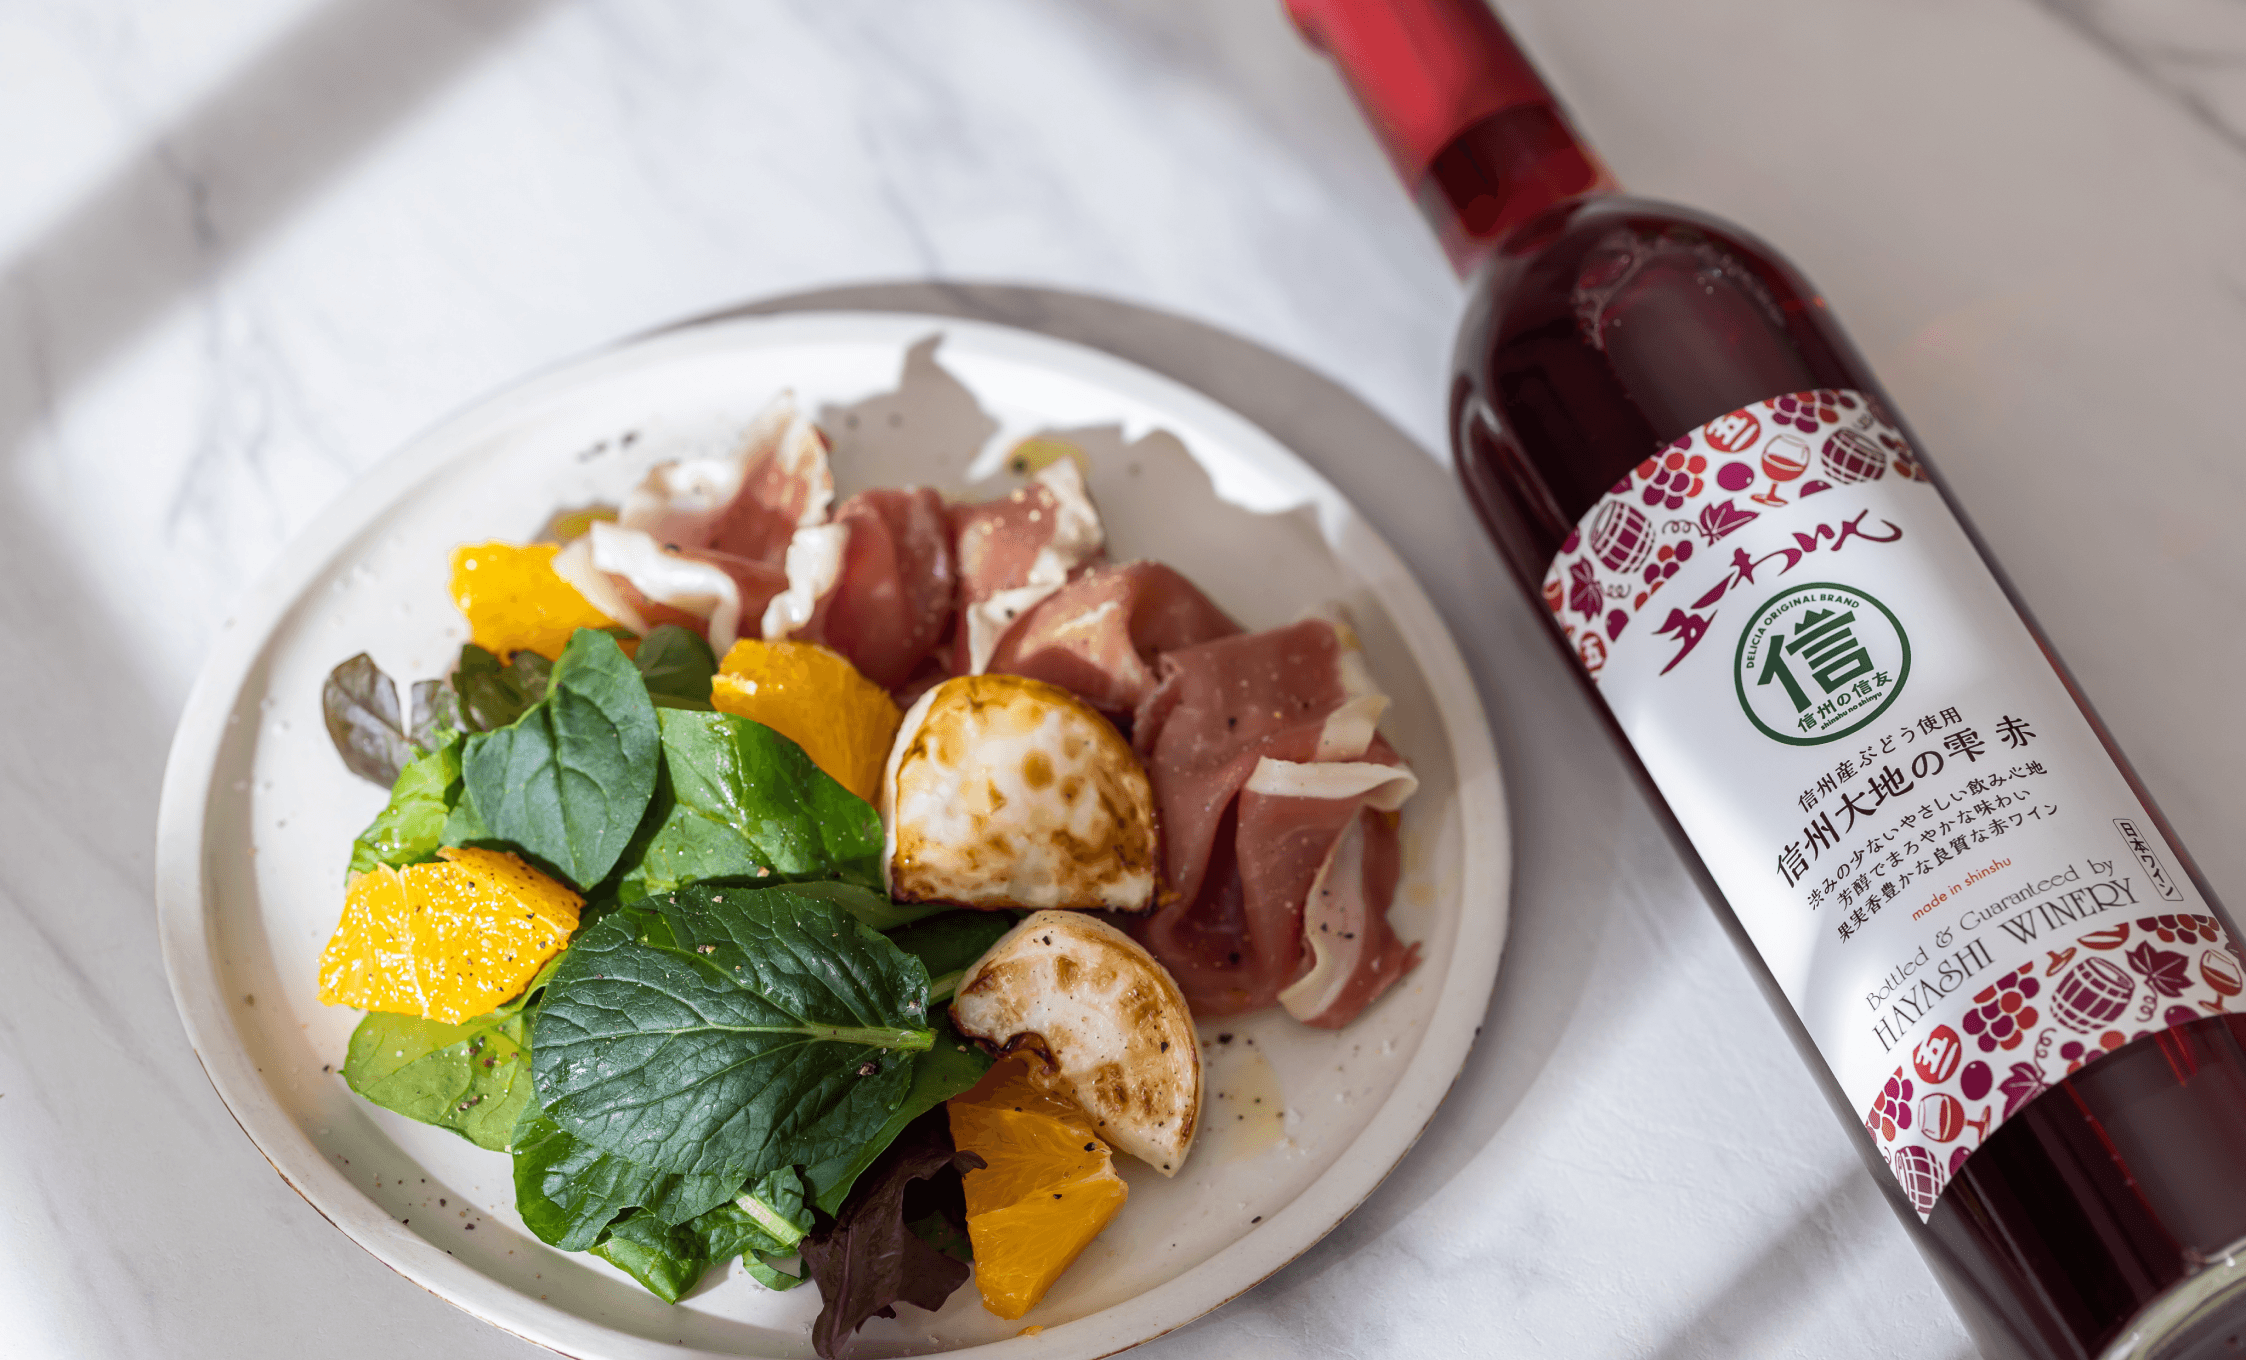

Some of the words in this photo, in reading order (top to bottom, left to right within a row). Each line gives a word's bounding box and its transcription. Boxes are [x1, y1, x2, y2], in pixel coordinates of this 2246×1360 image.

[1745, 626, 1767, 669] DELICIA
[1763, 594, 1817, 626] ORIGINAL
[1819, 593, 1860, 609] BRAND
[1756, 607, 1875, 714] 信
[1797, 670, 1893, 733] 信州の信友
[1820, 709, 1848, 731] shinshu
[1847, 704, 1858, 713] no
[1858, 691, 1882, 708] shinyu
[1776, 727, 1985, 888] 信州大地の雫
[1995, 714, 2037, 749] 赤
[1797, 706, 1963, 813] 信州産ぶどう使用
[1806, 759, 2048, 911] 渋みの少ないやさしい飲み心地
[1835, 789, 2031, 911] 芳醇でまろやかな味わい
[1836, 803, 2058, 944] 果実香豊かな良質な赤ワイン
[2119, 822, 2174, 897] 日本ワイン
[1865, 945, 1930, 1013] Bottled
[1935, 925, 1954, 949] &
[1959, 864, 2081, 931] Guaranteed
[2087, 858, 2114, 878] by
[1911, 893, 1948, 922] made
[1947, 883, 1963, 896] in
[1964, 857, 2013, 887] shinshu
[1872, 937, 1996, 1055] HAYASHI
[1997, 877, 2140, 946] WINERY
